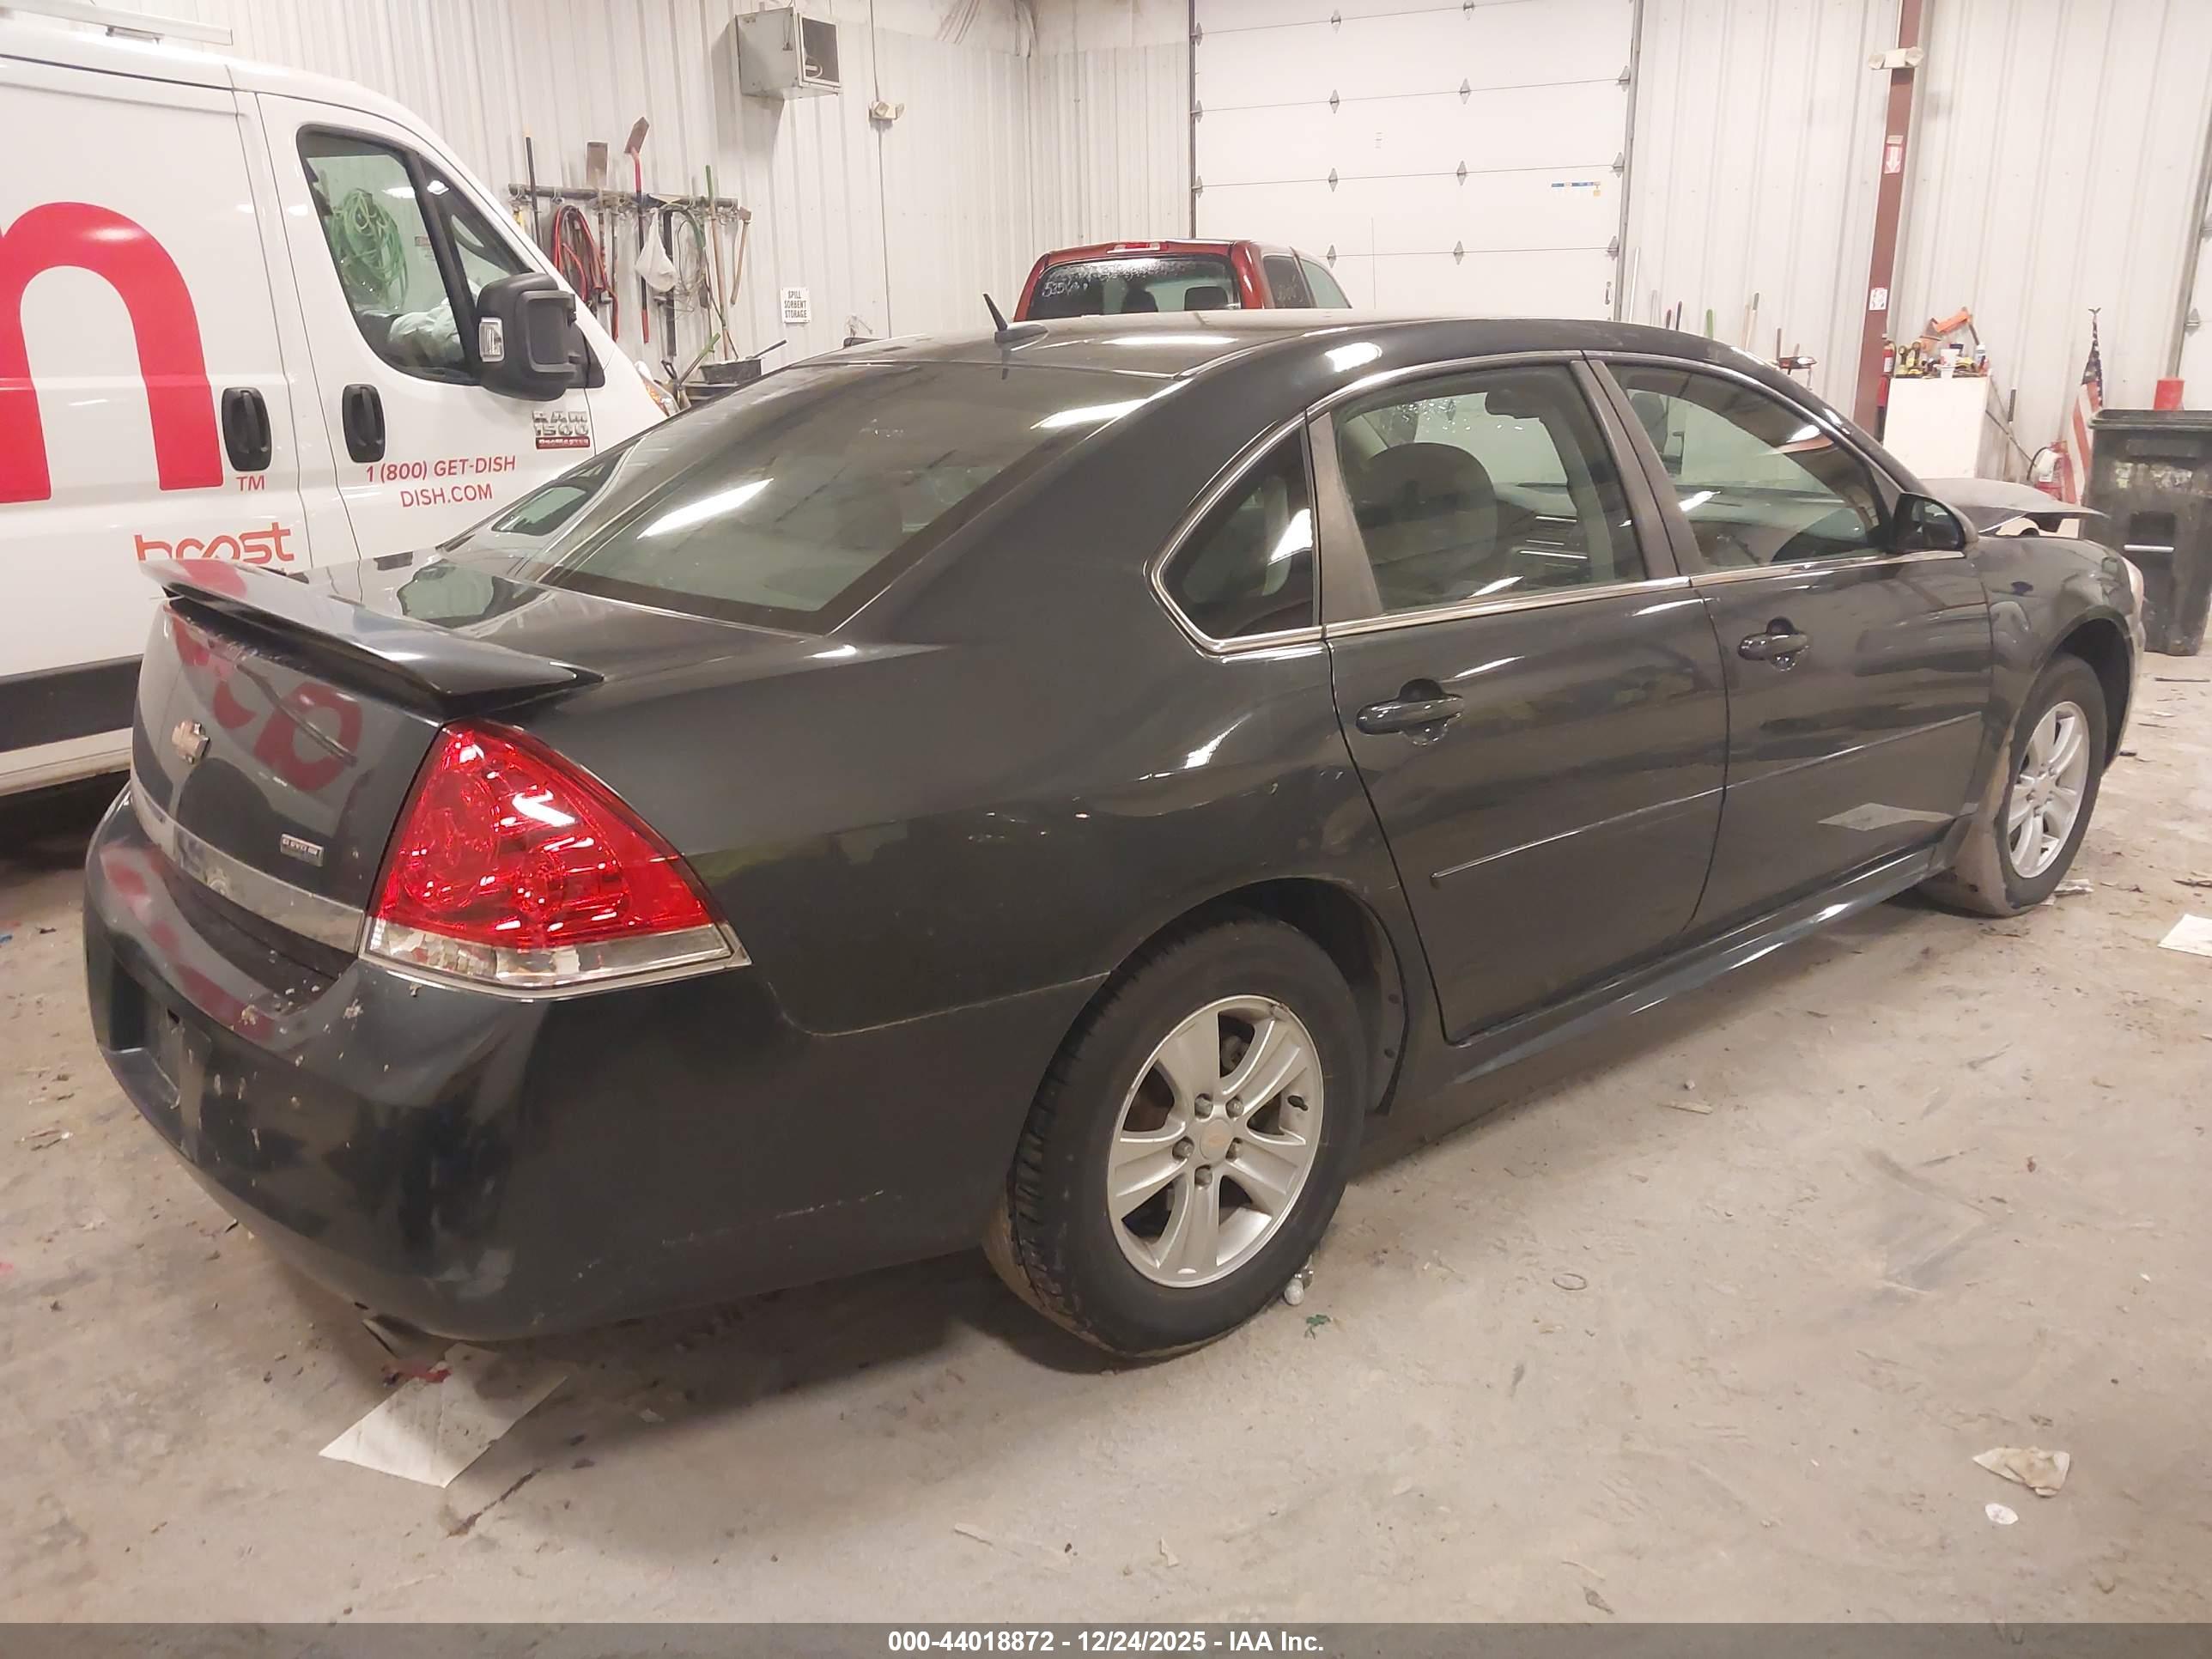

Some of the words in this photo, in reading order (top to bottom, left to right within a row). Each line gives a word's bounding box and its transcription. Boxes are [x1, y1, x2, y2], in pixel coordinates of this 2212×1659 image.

[787, 290, 801, 299] SPILL
[784, 300, 806, 309] SORBENT
[785, 309, 807, 318] STORAGE
[532, 410, 588, 423] RAM
[534, 423, 589, 436] 1500
[367, 466, 375, 482] 1
[380, 460, 428, 483] (800)
[433, 455, 516, 477] GET-DISH
[236, 475, 265, 492] TM
[400, 483, 493, 507] DISH.COM
